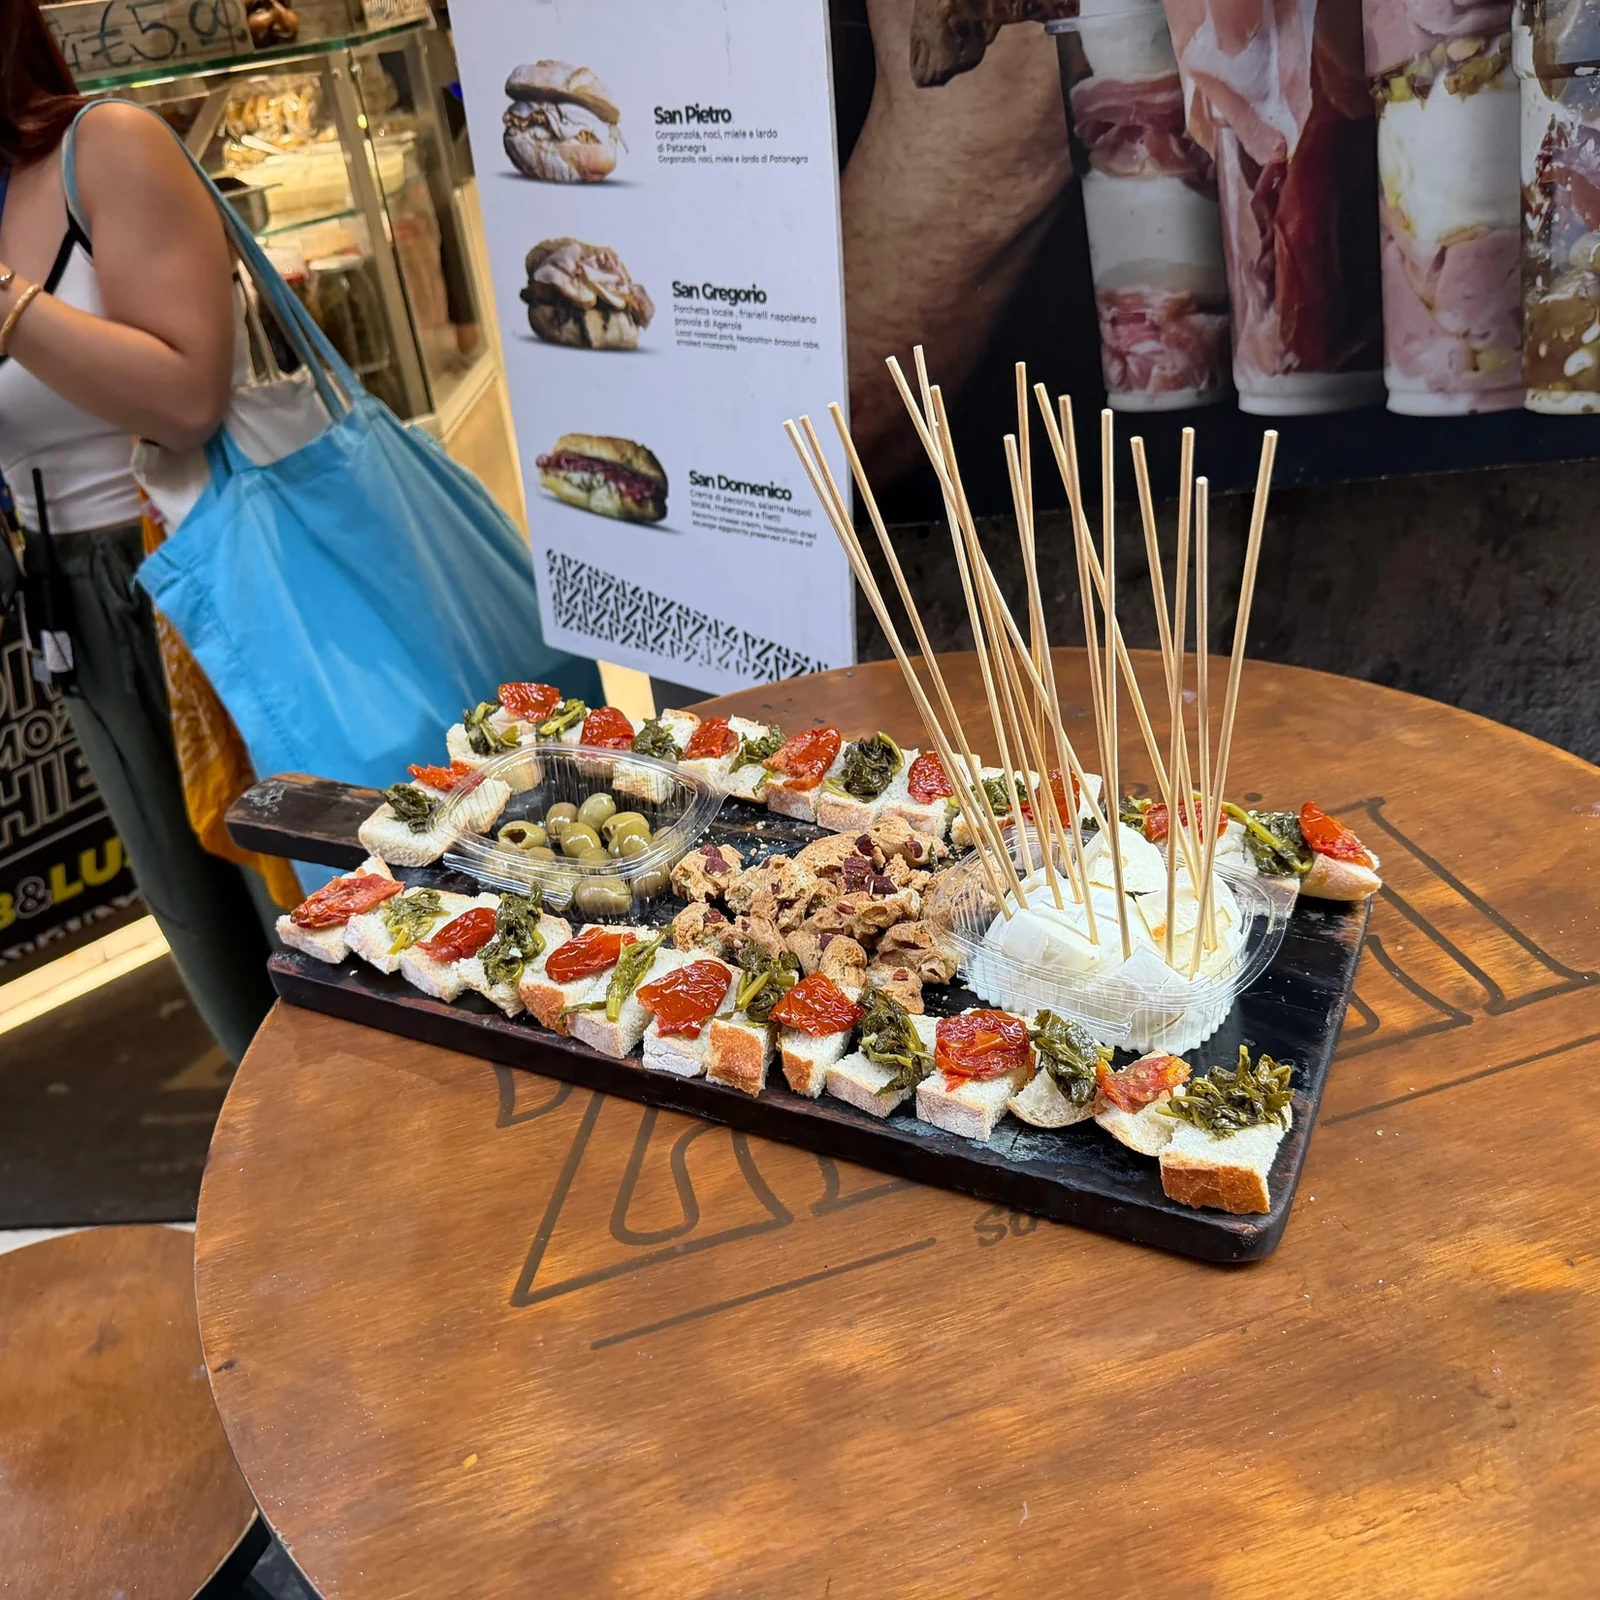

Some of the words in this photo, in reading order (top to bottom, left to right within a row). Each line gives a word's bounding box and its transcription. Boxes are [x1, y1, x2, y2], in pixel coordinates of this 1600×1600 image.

[654, 105, 682, 125] San
[685, 103, 732, 124] Pietro
[656, 130, 702, 142] Gorgonzola,
[704, 130, 722, 140] noci,
[724, 130, 747, 139] miele
[756, 129, 778, 139] lardo
[657, 144, 664, 152] di
[666, 144, 706, 154] Patanegra
[716, 155, 734, 163] miele
[761, 155, 768, 163] di
[672, 280, 700, 300] San
[702, 283, 768, 306] Gregorio
[674, 304, 710, 315] Porchetta
[689, 470, 715, 488] San
[717, 474, 792, 500] Domenico
